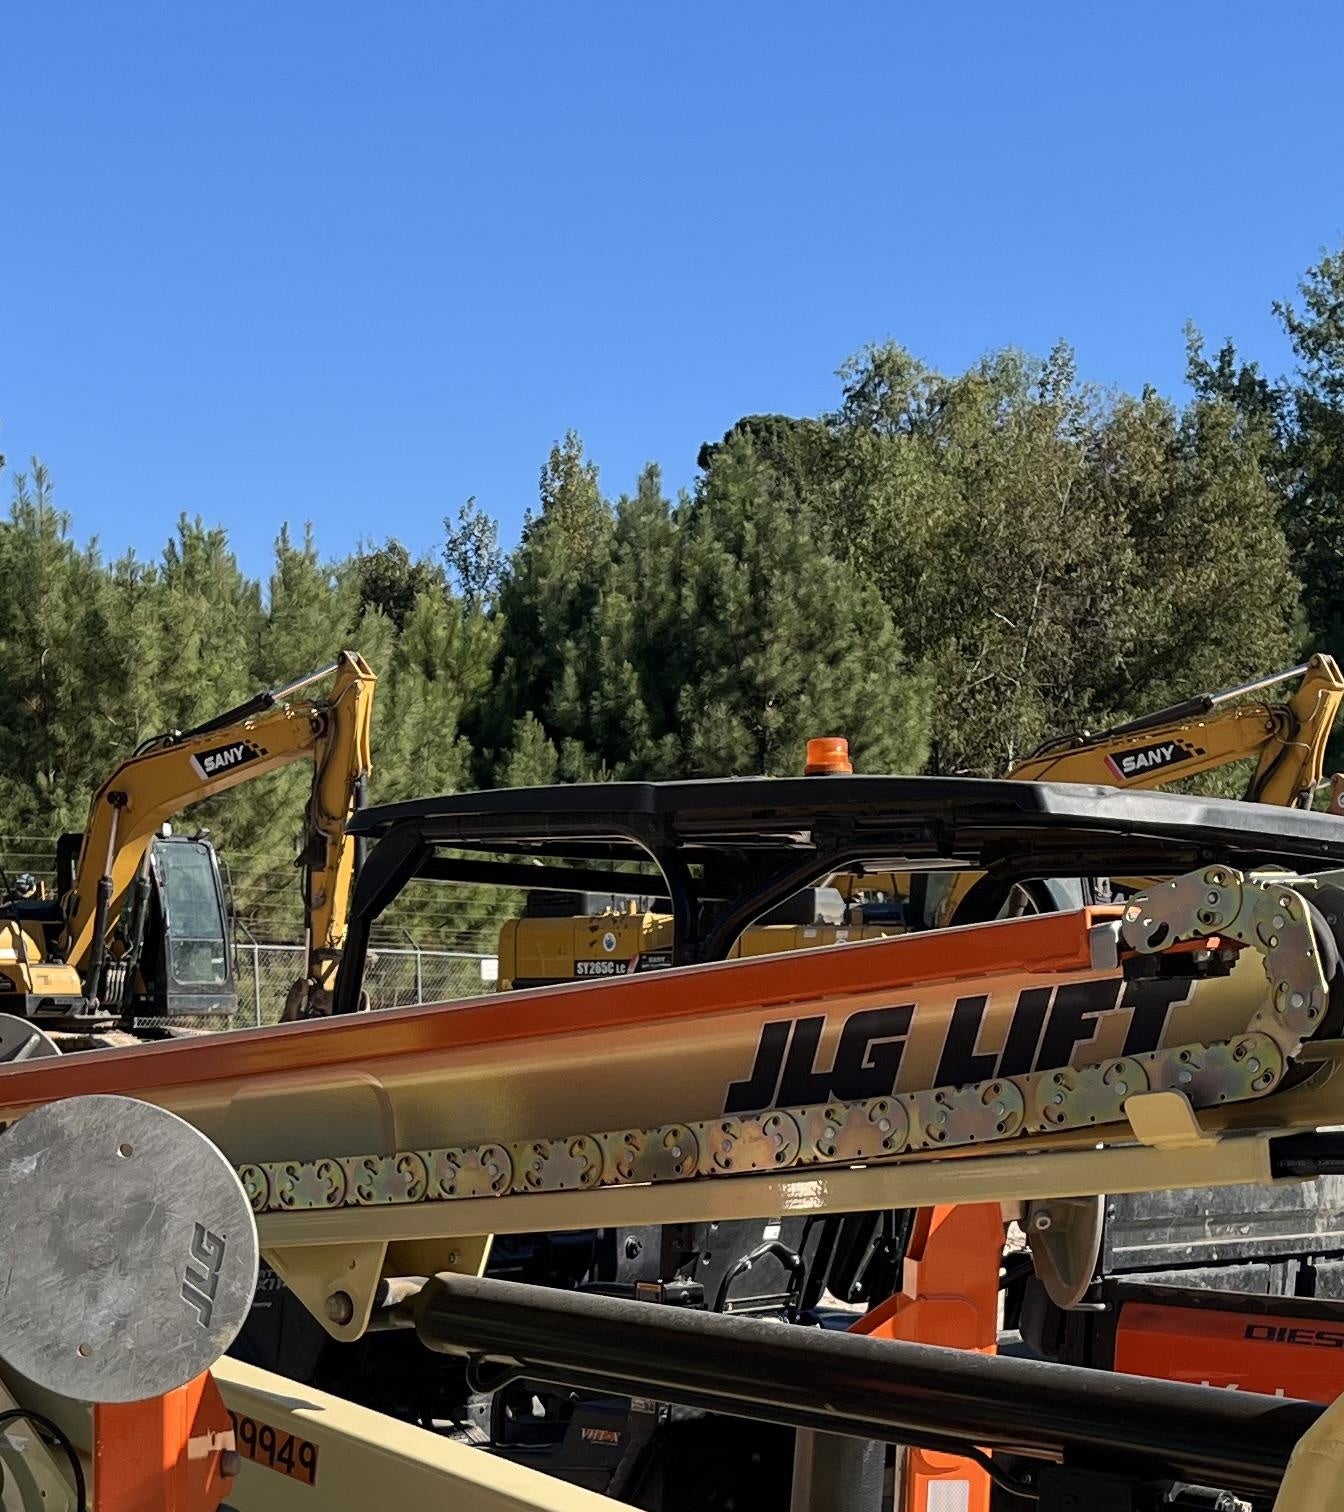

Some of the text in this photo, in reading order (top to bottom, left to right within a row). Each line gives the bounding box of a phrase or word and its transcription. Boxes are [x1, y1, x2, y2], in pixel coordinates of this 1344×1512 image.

[204, 745, 244, 772] SANY
[1122, 744, 1174, 773] SANY
[577, 961, 614, 975] SY265C
[723, 977, 1194, 1115] JLG LIFT
[180, 1222, 227, 1329] JLG
